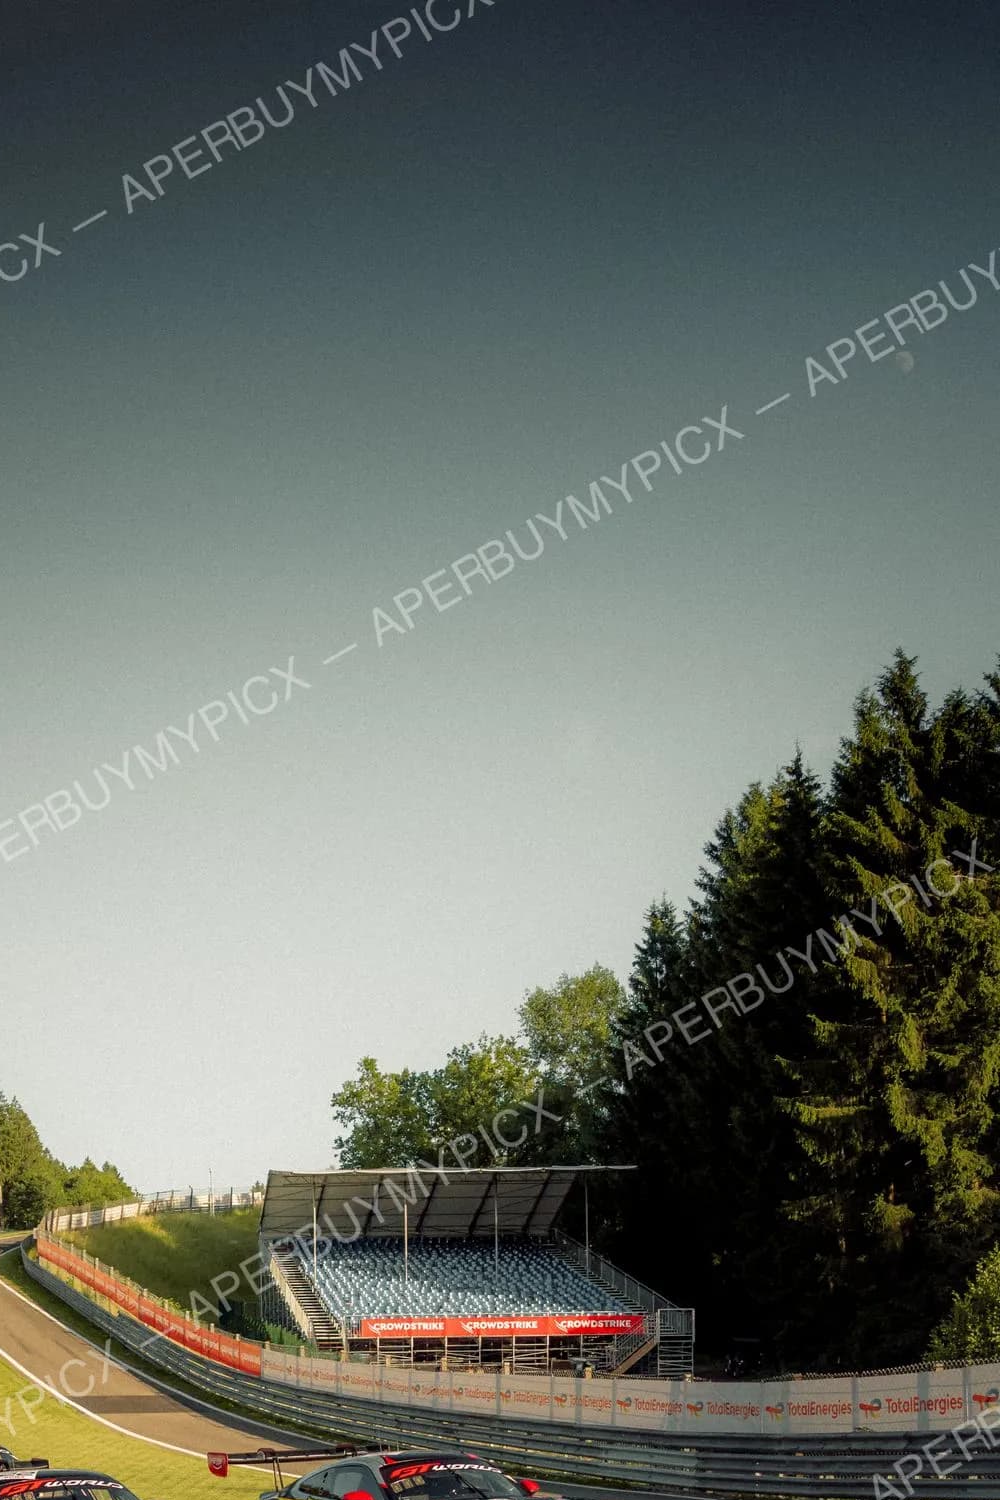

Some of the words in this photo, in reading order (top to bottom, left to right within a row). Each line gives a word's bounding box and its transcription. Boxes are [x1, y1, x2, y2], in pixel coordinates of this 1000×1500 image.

[373, 1322, 445, 1331] CROWDSTRIKE
[467, 1320, 538, 1330] CROWDSTRIKE
[561, 1319, 632, 1329] CROWDSTRIKE
[570, 1394, 612, 1411] TotalEnergies
[634, 1397, 682, 1416] TotalEnergies
[706, 1401, 760, 1420] TotalEnergies
[787, 1400, 852, 1420] TotalEnergies
[885, 1395, 964, 1415] TotalEnergies
[390, 1462, 441, 1480] GT
[0, 1478, 55, 1497] GT
[44, 1479, 124, 1490] WORLD
